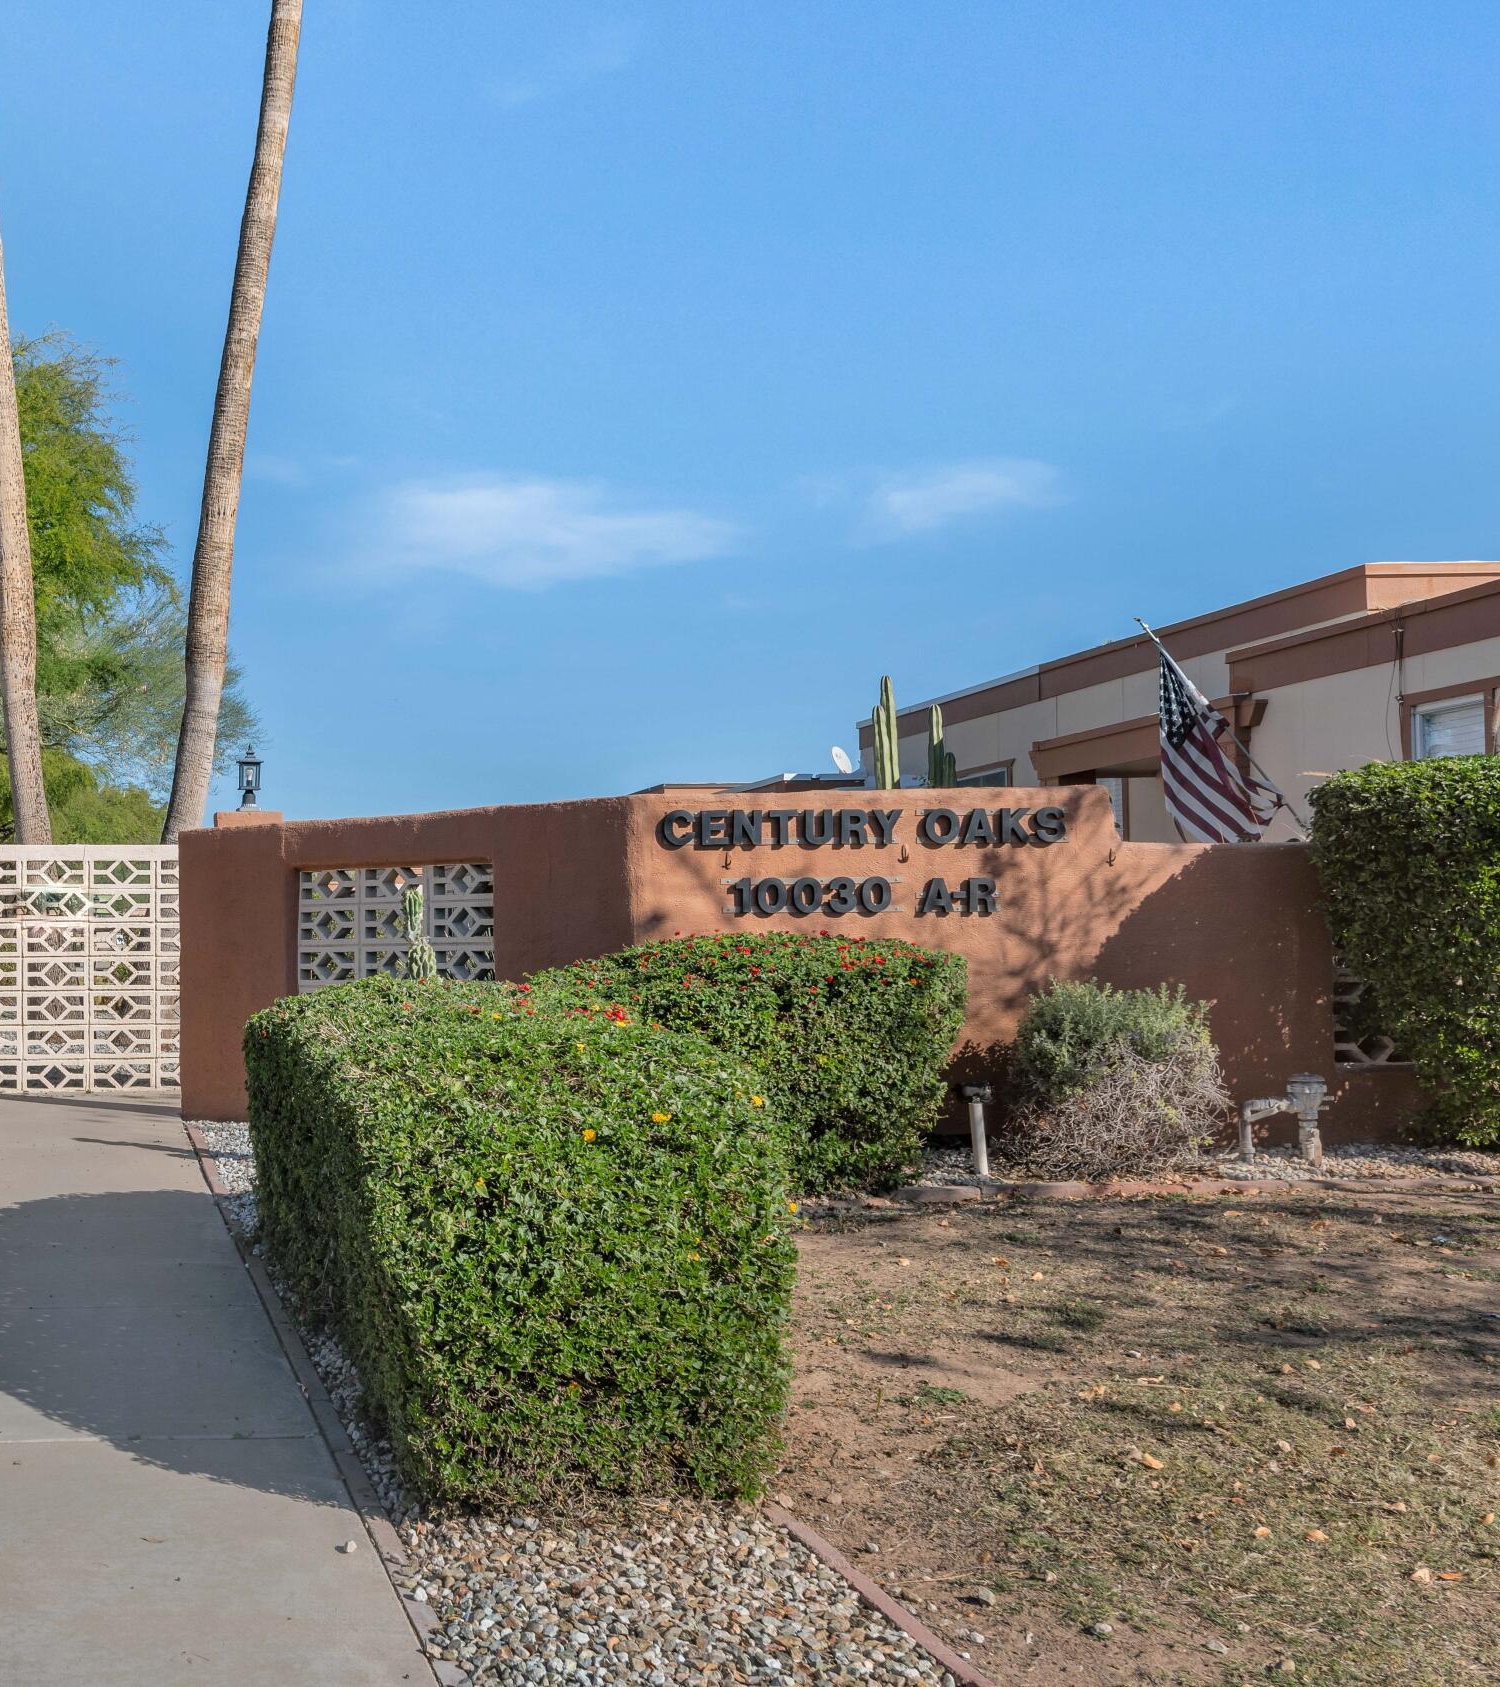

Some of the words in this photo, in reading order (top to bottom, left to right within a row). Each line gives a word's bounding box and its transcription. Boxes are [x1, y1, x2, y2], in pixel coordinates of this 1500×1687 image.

[660, 808, 901, 846] CENTURY
[923, 807, 1067, 844] OAKS
[733, 877, 891, 914] 10030
[920, 877, 997, 914] A-R
